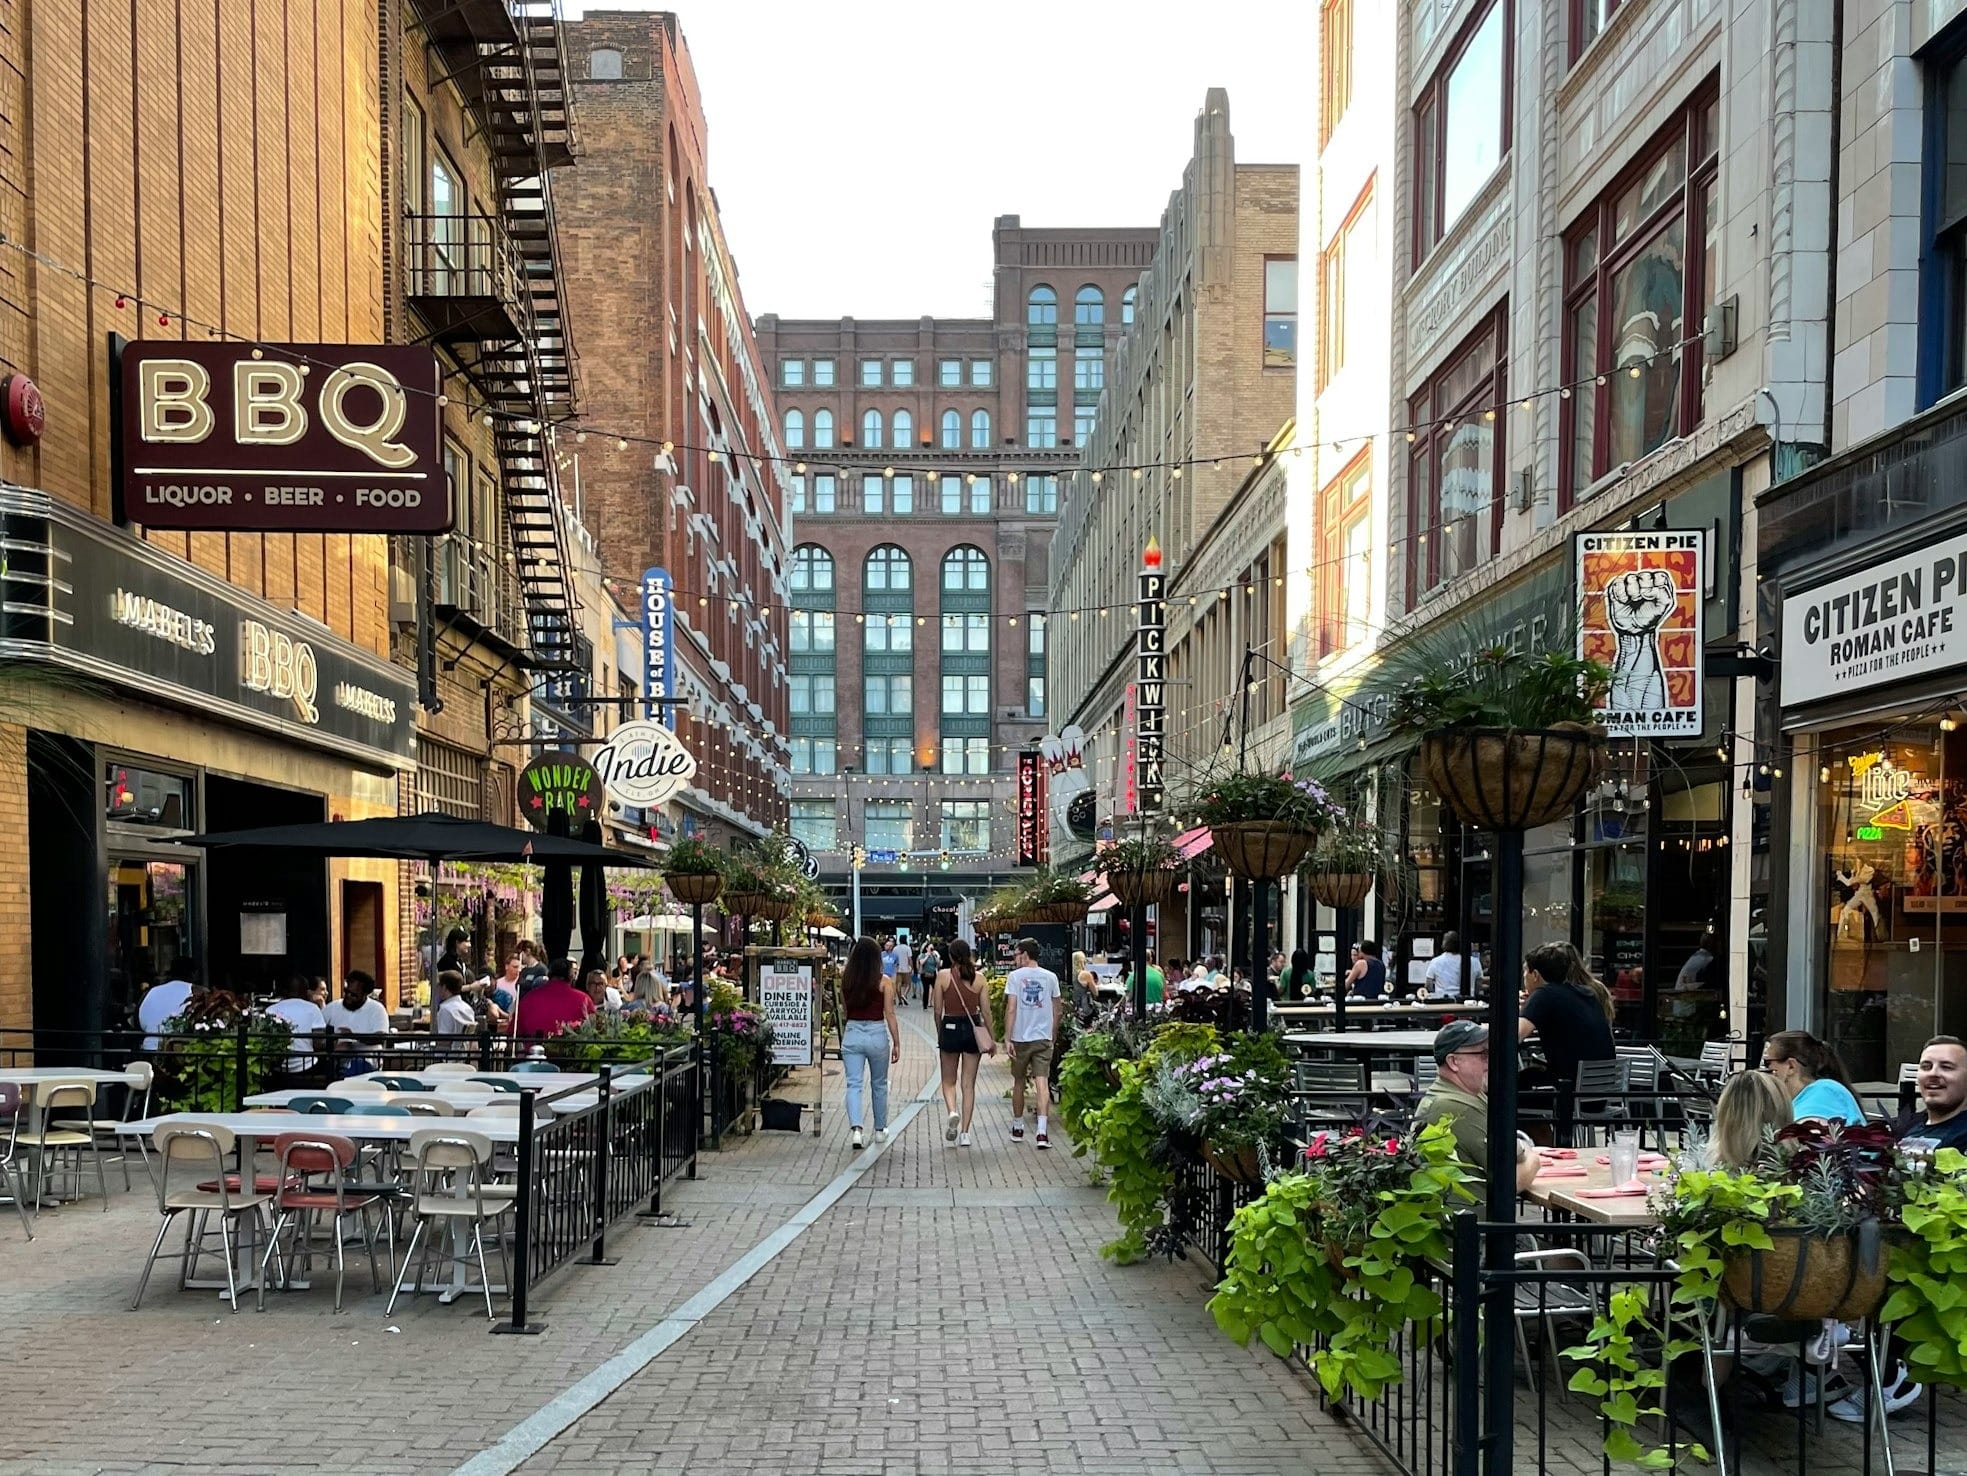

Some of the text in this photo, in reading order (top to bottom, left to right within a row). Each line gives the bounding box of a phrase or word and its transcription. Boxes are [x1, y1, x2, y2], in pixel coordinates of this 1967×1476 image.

[139, 358, 418, 468] BBQ
[145, 484, 421, 508] LIQUOR BEER FOOD
[1584, 535, 1697, 551] CITIZEN PIE
[1803, 567, 1922, 645] CITIZEN
[646, 578, 666, 666] HOUSE
[1830, 606, 1953, 666] ROMAN CAFE
[239, 618, 320, 724] BBQ
[649, 667, 663, 678] of
[1848, 643, 1929, 679] PIZZA FOR THE PEOPLE
[1144, 577, 1161, 783] PICKWICK
[1593, 710, 1697, 724] OMAN CAFE
[1653, 723, 1680, 731] PEOPLE
[593, 742, 691, 785] Indie
[527, 764, 592, 792] WONDER
[1859, 767, 1910, 811] Lite
[545, 790, 577, 816] BAR
[1856, 826, 1883, 840] PIZZA
[764, 975, 808, 990] OPEN
[764, 992, 808, 1001] DINE IN
